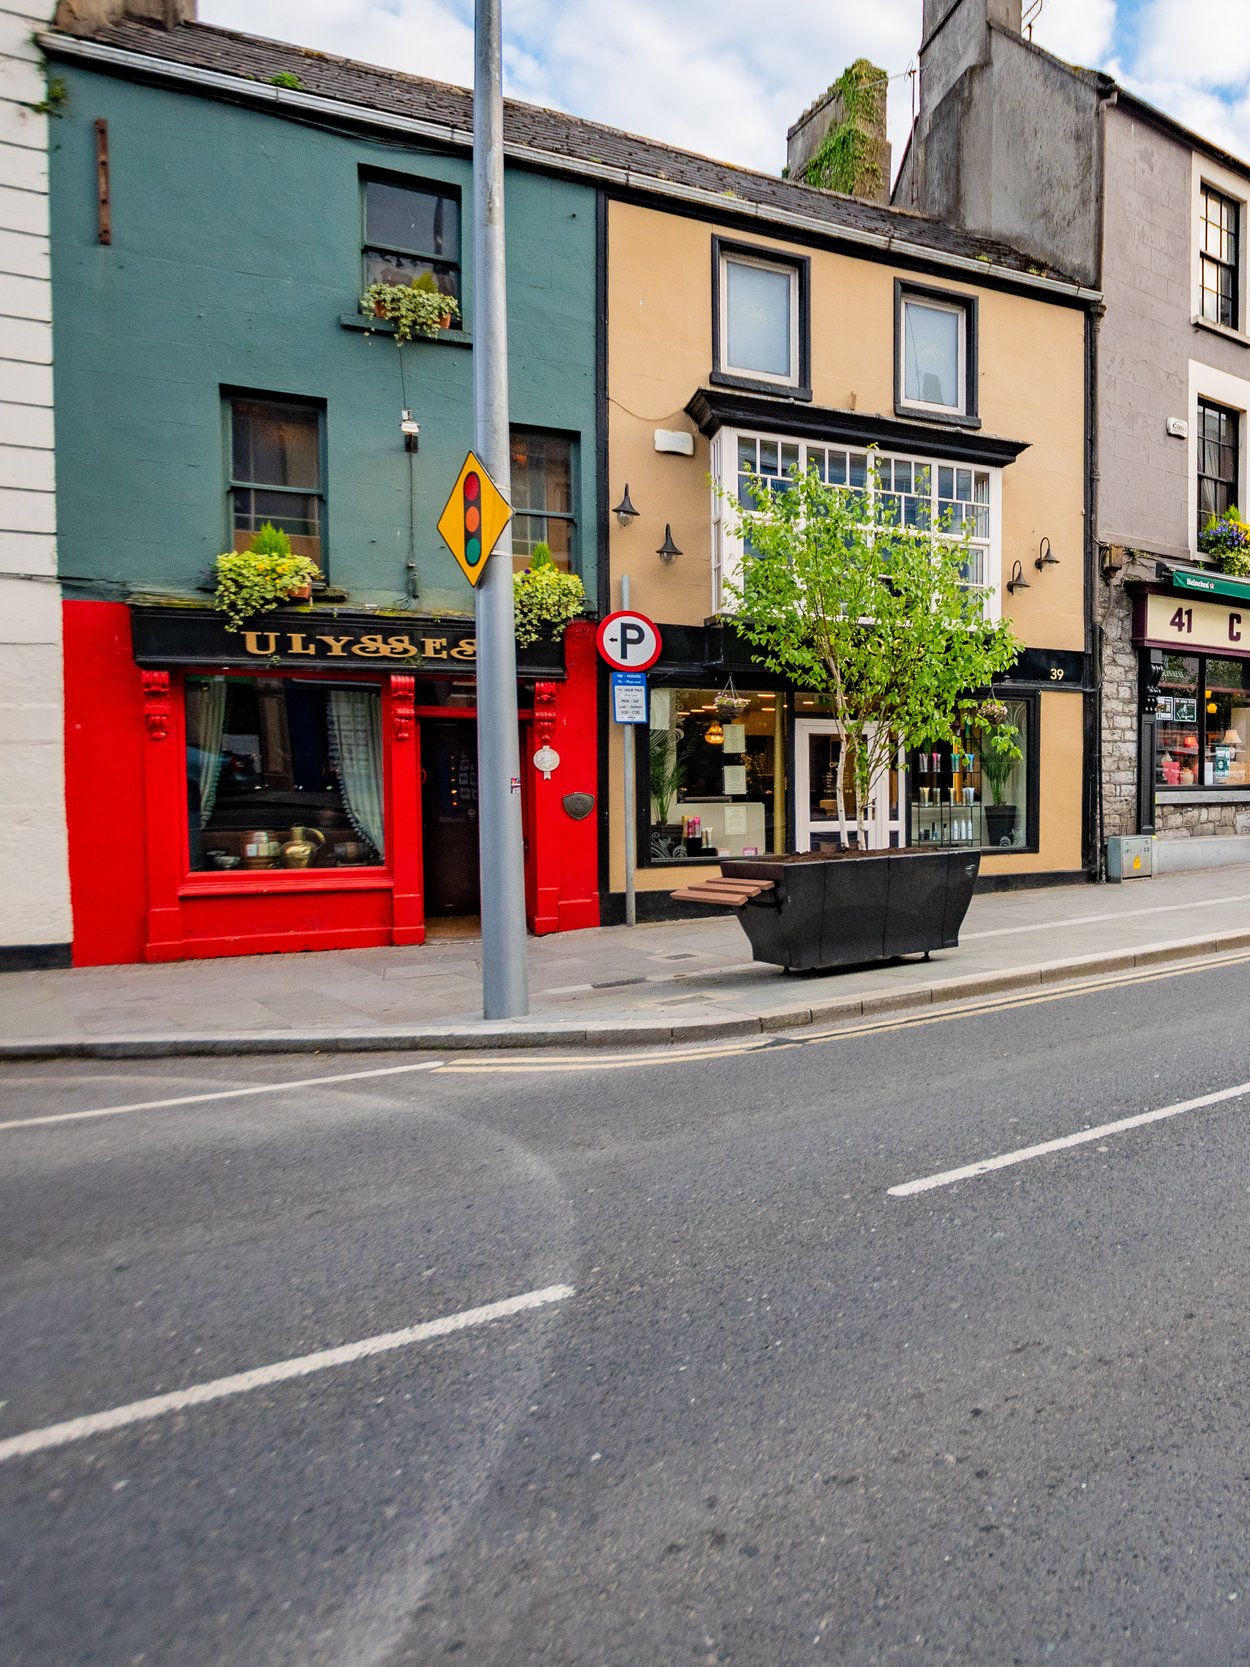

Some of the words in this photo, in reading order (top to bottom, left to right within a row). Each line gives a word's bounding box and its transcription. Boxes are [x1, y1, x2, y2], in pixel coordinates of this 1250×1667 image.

[1169, 607, 1193, 633] 41
[240, 631, 477, 660] ULYSSES
[620, 622, 645, 660] P
[1050, 668, 1064, 680] 39
